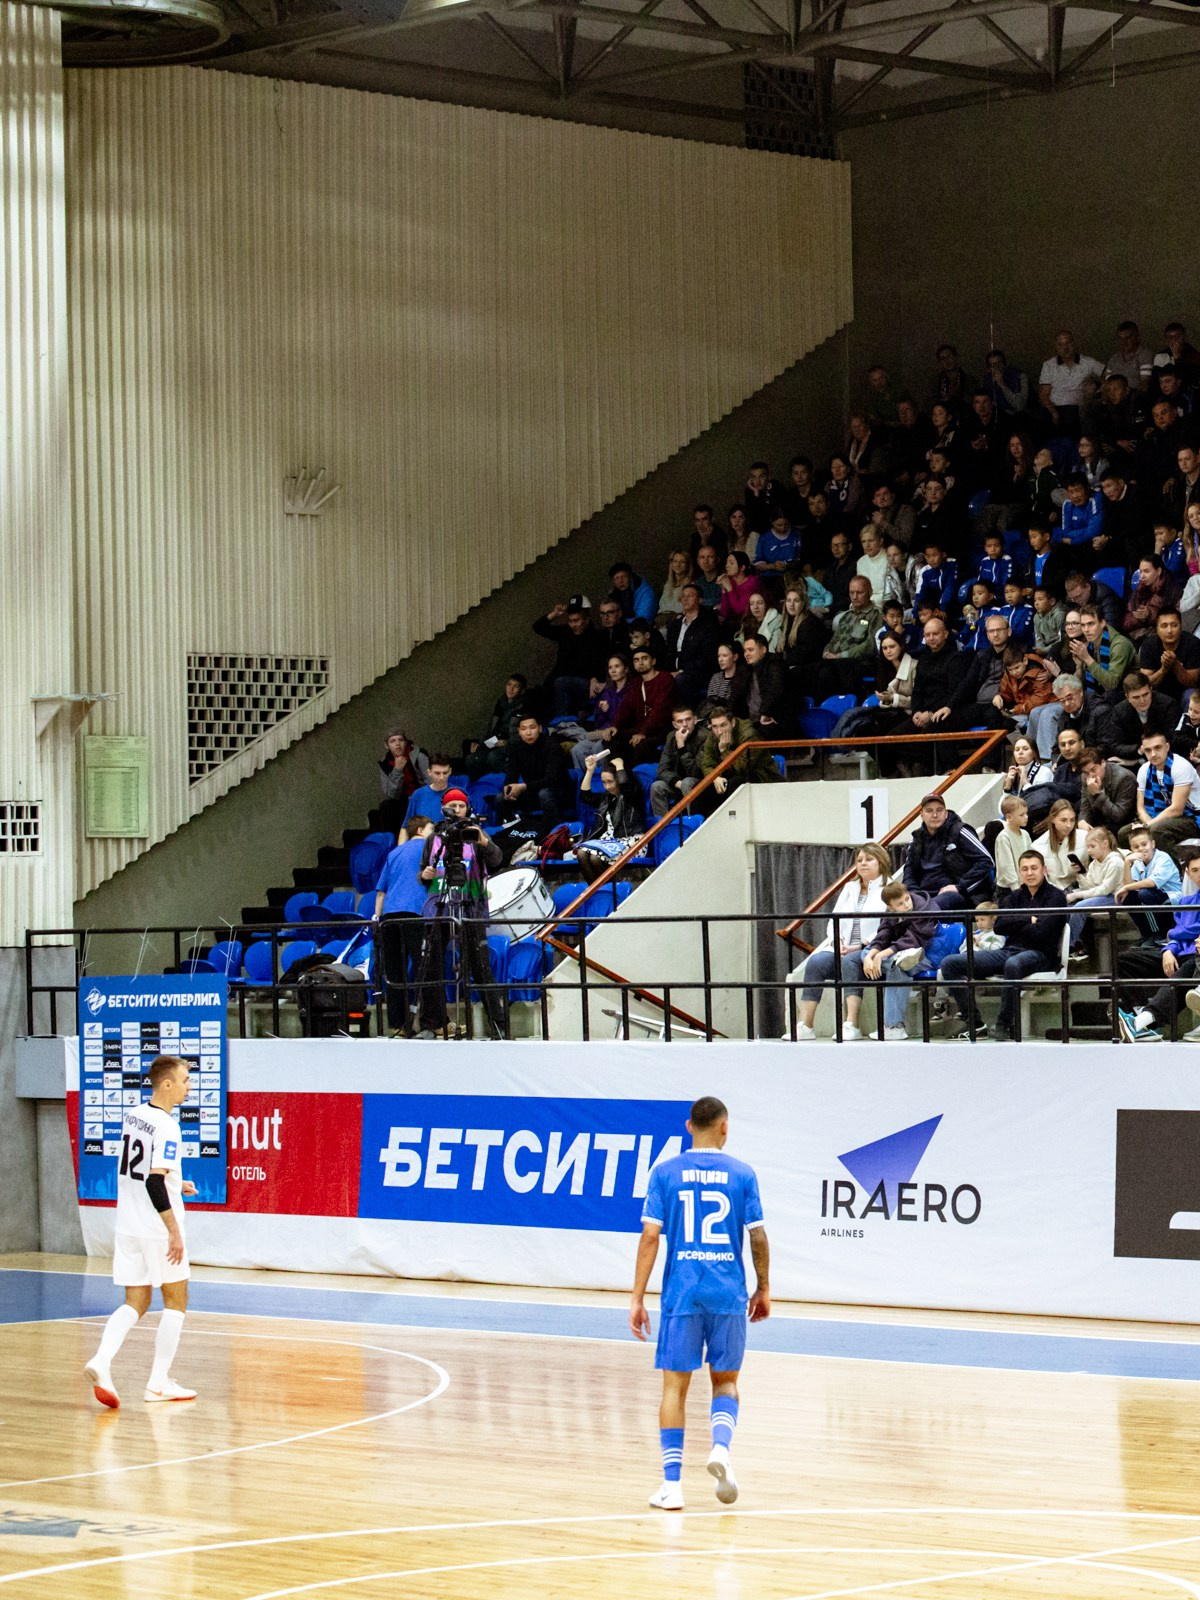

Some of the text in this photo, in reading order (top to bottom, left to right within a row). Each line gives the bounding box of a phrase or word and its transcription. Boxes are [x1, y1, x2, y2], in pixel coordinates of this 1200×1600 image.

[861, 795, 874, 839] 1
[108, 992, 221, 1008] БЕТСИТИ СУПЕРЛИГА
[119, 1133, 145, 1182] 12
[232, 1166, 267, 1181] ОТЕЛЬ
[380, 1126, 683, 1198] БЕТСИТИ
[678, 1190, 731, 1244] 12
[821, 1178, 982, 1226] IRAERO
[821, 1228, 865, 1238] AIRLINES
[684, 1250, 735, 1262] сервико
